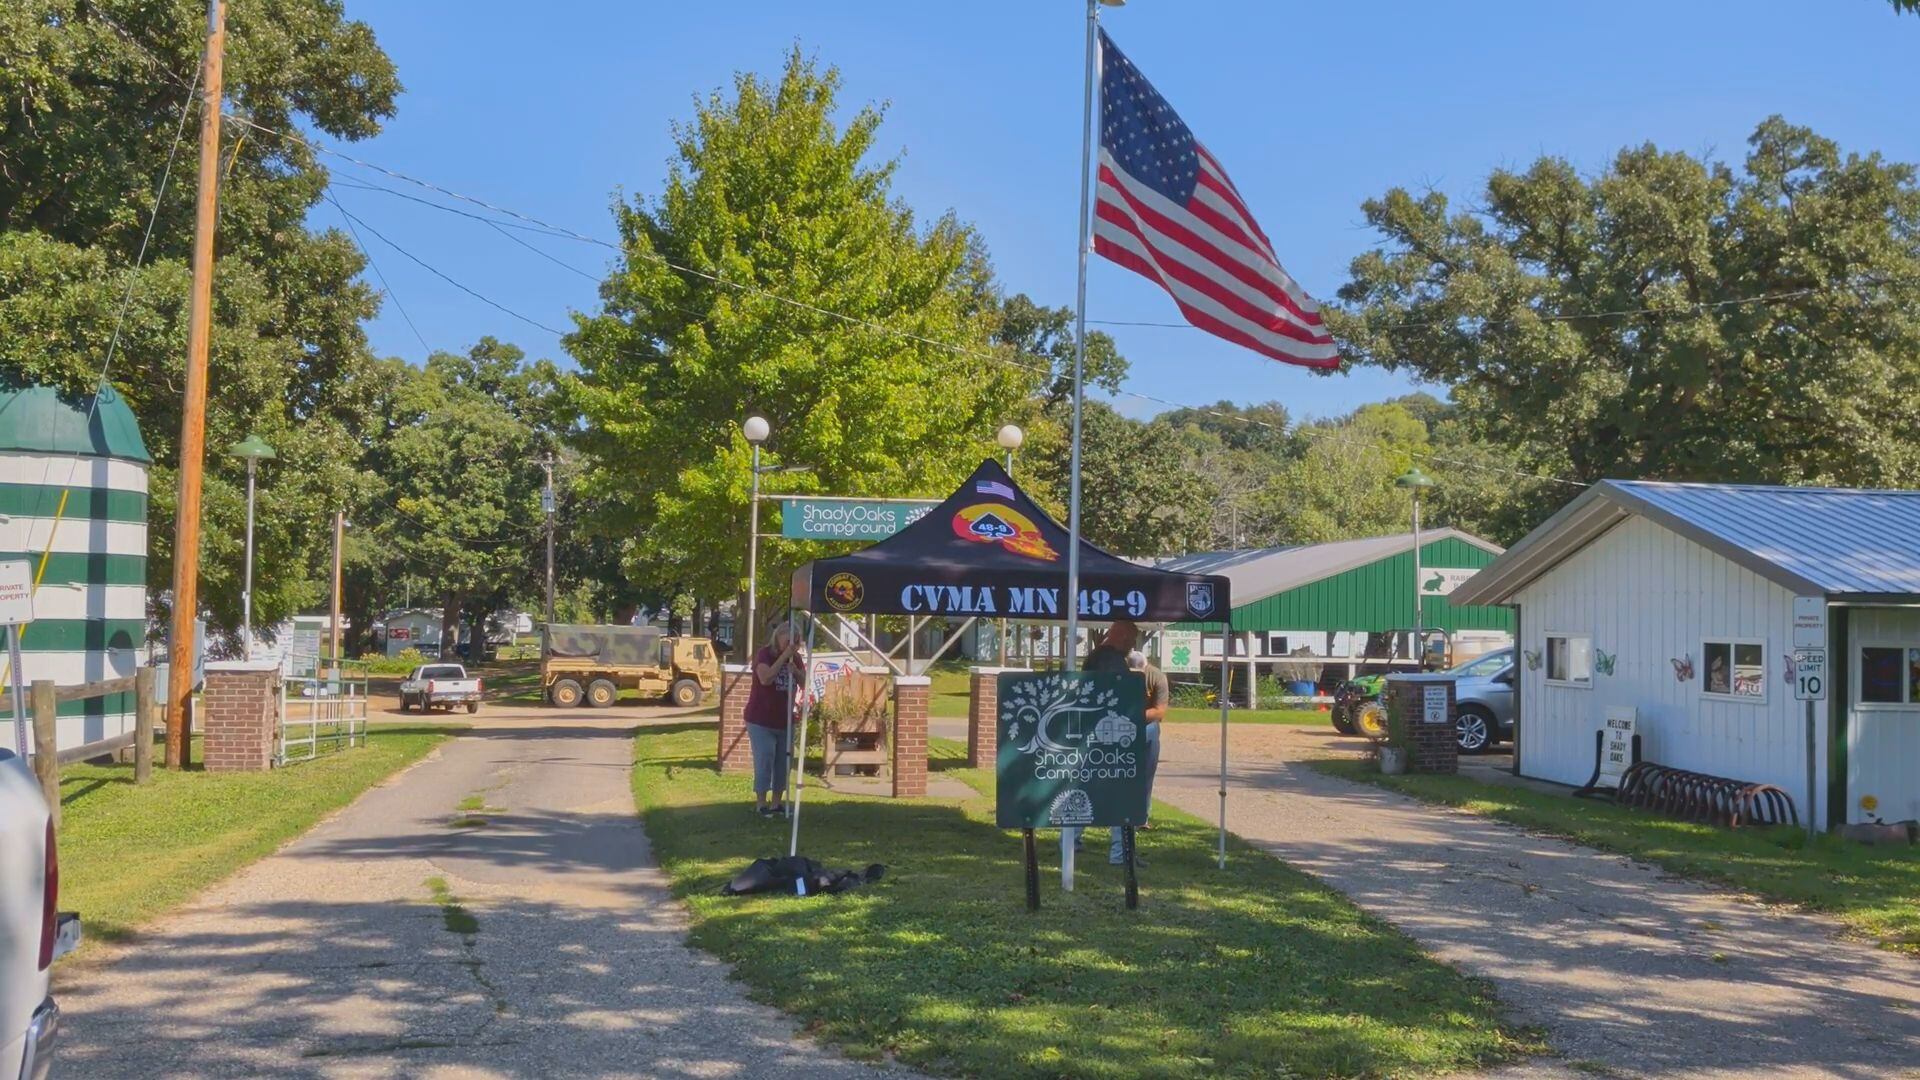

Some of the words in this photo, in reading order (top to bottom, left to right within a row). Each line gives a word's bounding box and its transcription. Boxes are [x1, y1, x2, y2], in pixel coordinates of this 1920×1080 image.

[802, 519, 896, 536] Campground
[978, 523, 1007, 533] 48-9
[0, 593, 29, 601] OPERTY
[901, 585, 996, 612] CVMA
[1008, 587, 1060, 614] MN
[1796, 655, 1824, 663] SPEED
[1799, 664, 1822, 672] LIMIT
[1799, 676, 1822, 694] 10
[1607, 719, 1632, 730] WELCOME
[1615, 730, 1622, 740] TO
[1610, 741, 1626, 751] SHADY
[1610, 752, 1624, 763] OAKS
[1034, 765, 1136, 782] Campground
